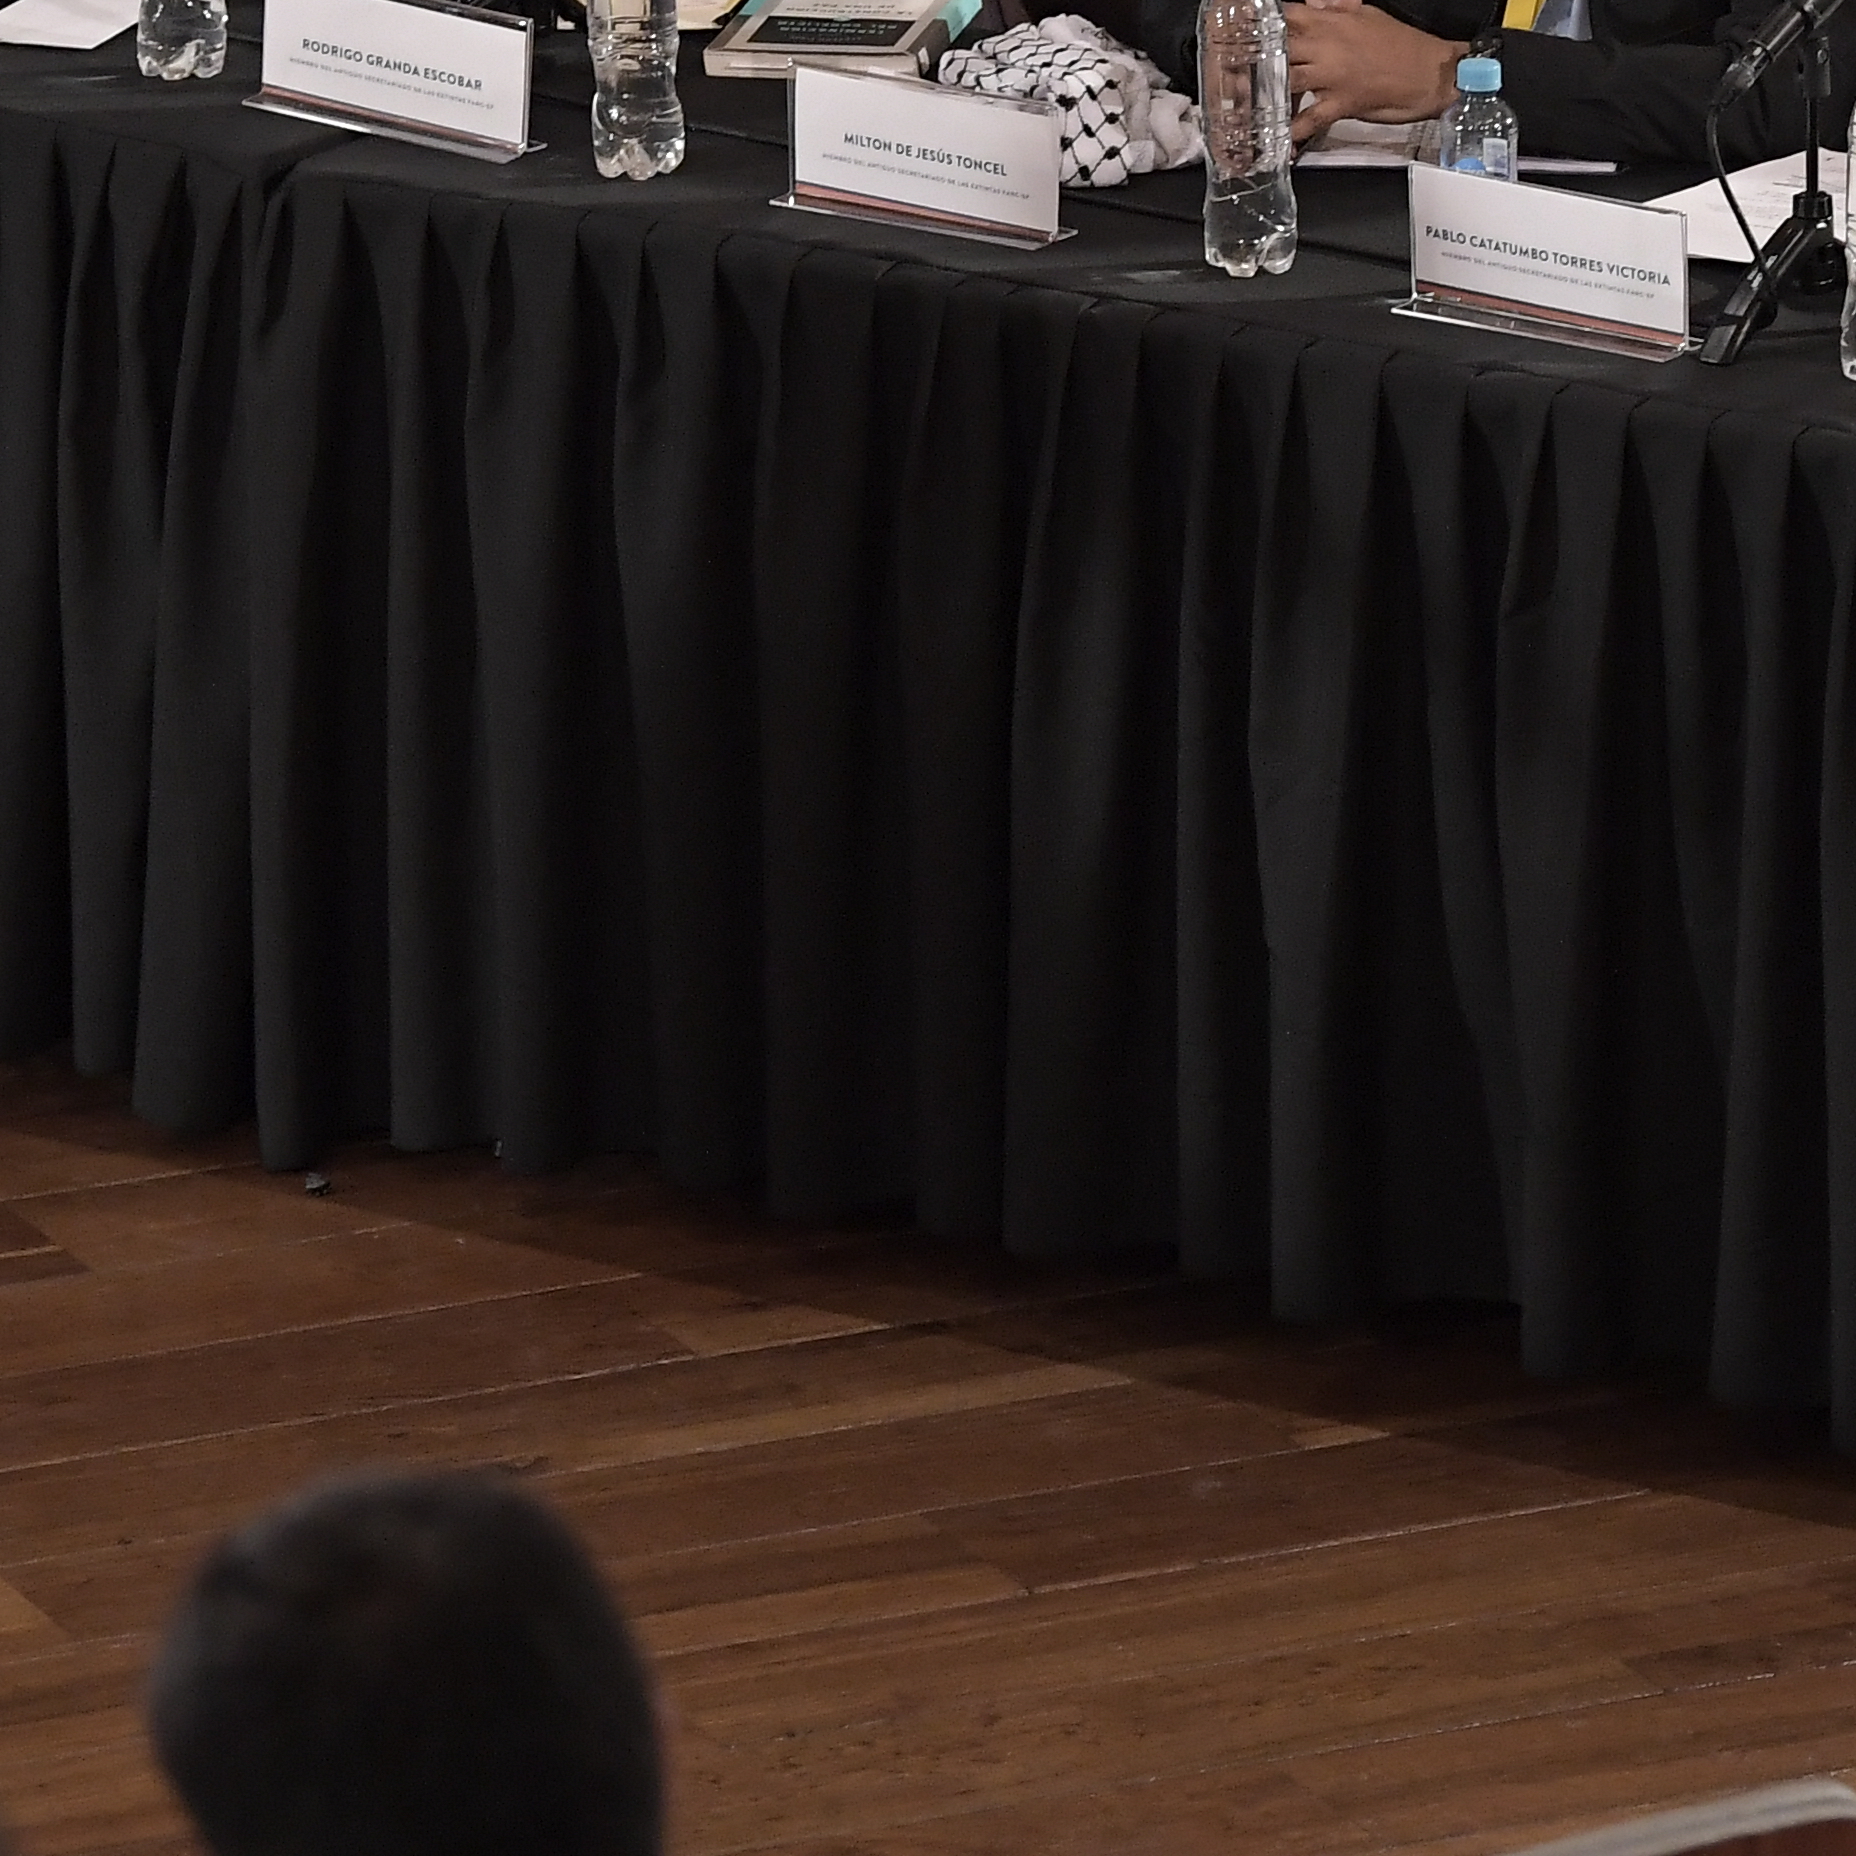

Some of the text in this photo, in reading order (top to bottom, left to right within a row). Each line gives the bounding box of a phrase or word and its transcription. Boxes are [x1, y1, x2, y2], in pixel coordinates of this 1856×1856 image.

[301, 39, 482, 91] RODRIGO GRANDA ESCOBAR
[843, 133, 1007, 176] MILTON DE JESÚS TONCEL
[1425, 226, 1671, 285] PABLO CATATUMBO TORRES VICTORIA
